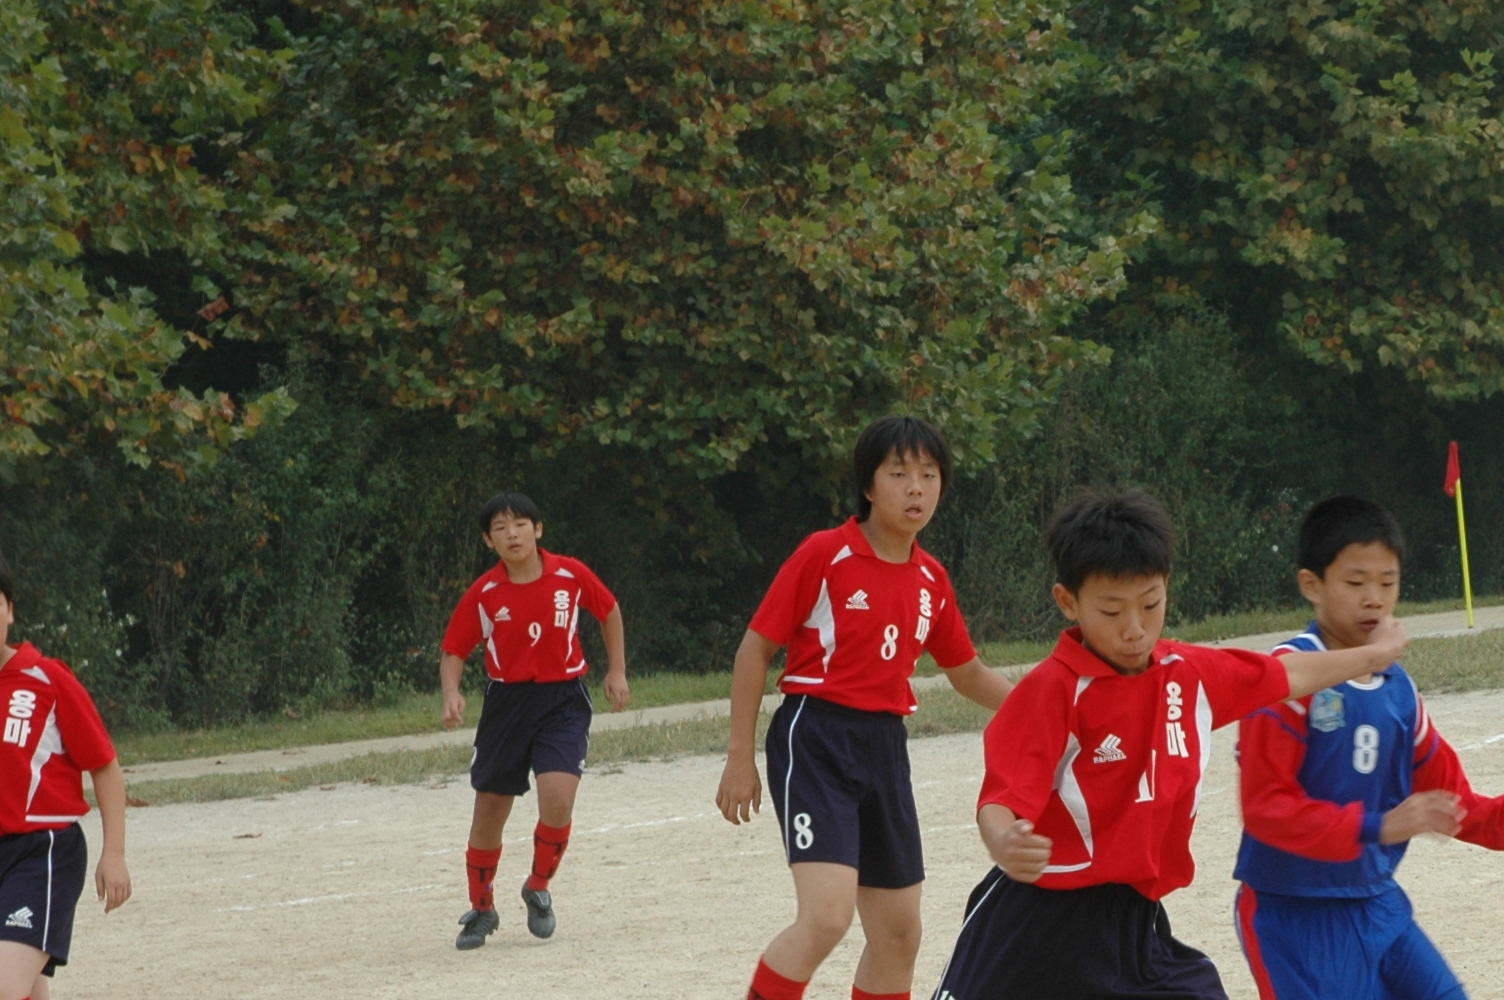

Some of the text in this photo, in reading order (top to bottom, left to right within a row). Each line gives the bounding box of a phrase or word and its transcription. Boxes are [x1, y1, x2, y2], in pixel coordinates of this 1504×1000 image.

[554, 590, 570, 630] 용마
[914, 588, 932, 645] 용마
[528, 622, 542, 648] 9
[880, 624, 899, 660] 8
[3, 688, 37, 748] 용마
[1166, 681, 1190, 758] 용마
[1352, 724, 1380, 774] 8
[793, 812, 814, 850] 8
